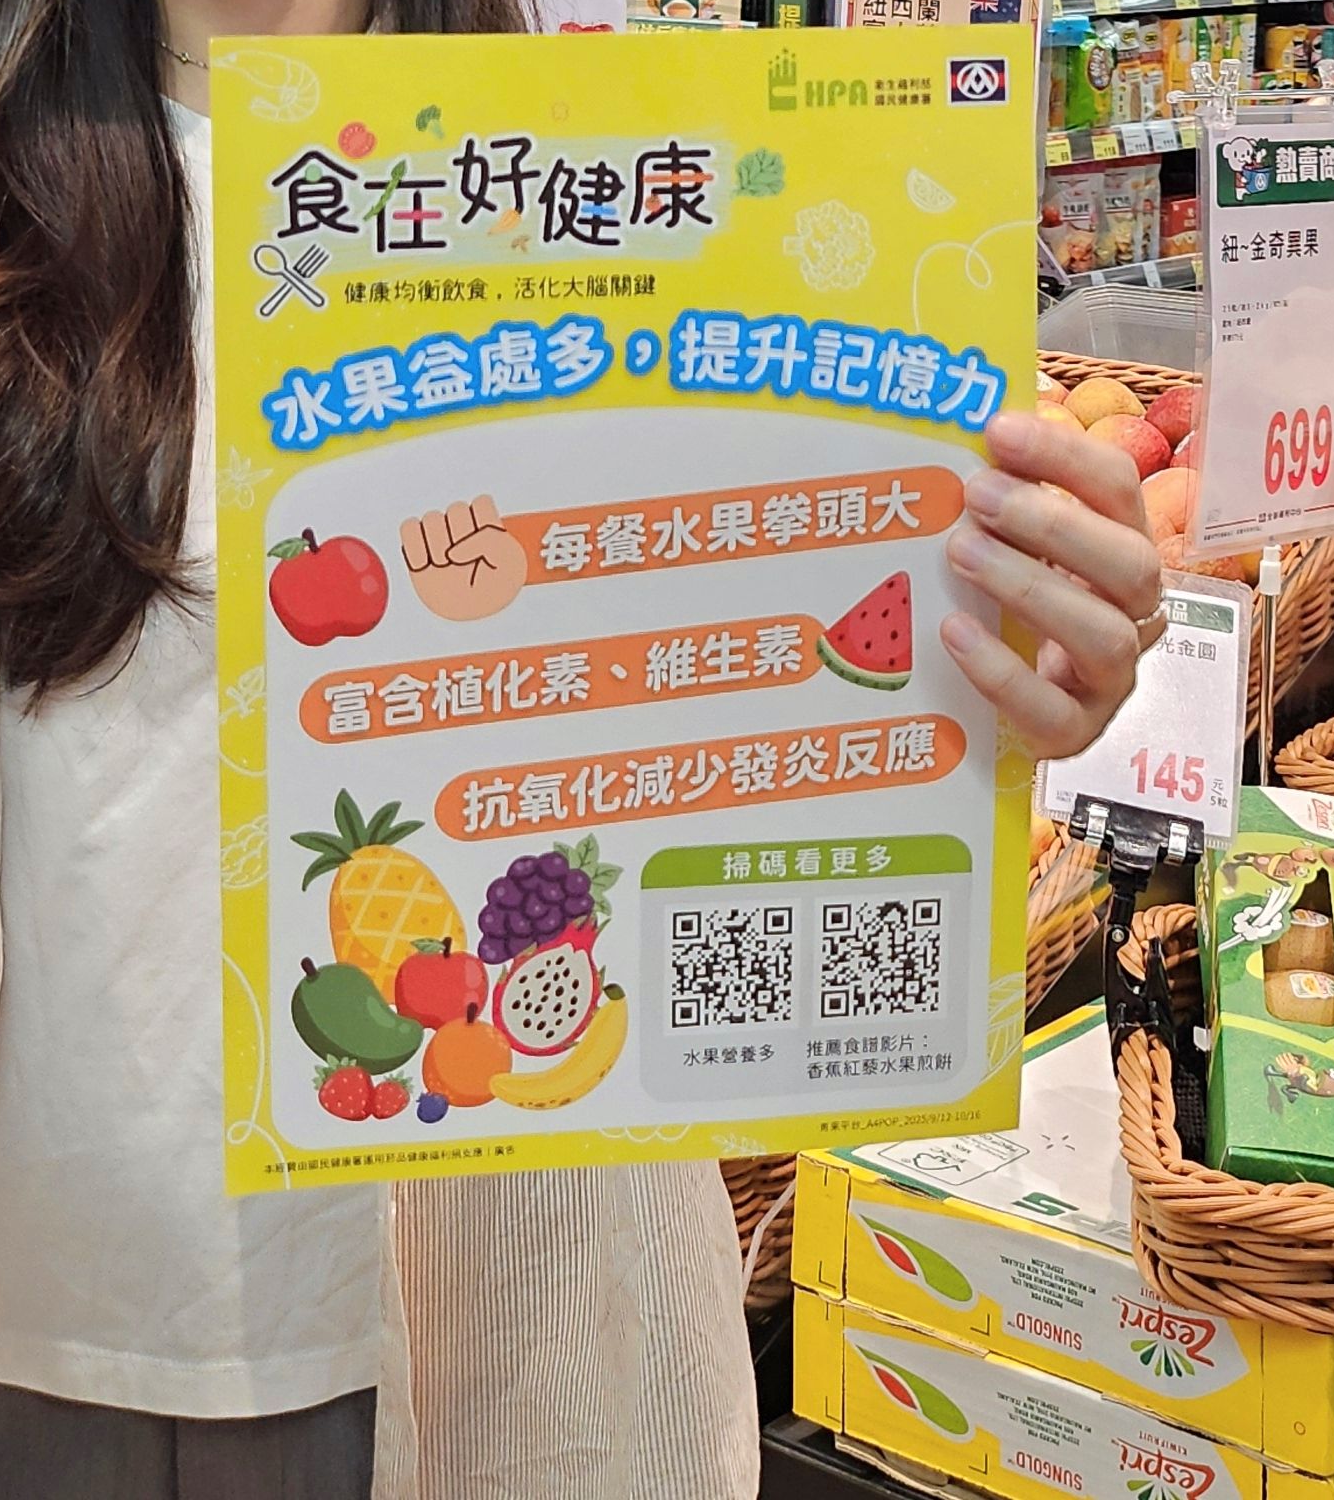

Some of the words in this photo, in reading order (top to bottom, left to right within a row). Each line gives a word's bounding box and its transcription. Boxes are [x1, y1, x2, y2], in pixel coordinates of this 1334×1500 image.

[805, 79, 868, 107] HPA
[270, 137, 714, 253] 食在好健康
[1263, 404, 1334, 496] 699
[538, 478, 924, 575] 每餐水果拳頭大
[322, 623, 806, 737] 富含植化素、維生素
[461, 721, 938, 835] 抗氧化減少發炎反應
[1129, 747, 1206, 803] 145
[722, 844, 893, 881] 掃碼看更多
[682, 1043, 776, 1067] 水果營養多
[1016, 1311, 1083, 1351] SUNGOLD
[1120, 1294, 1216, 1367] Zespri
[1016, 1450, 1083, 1492] SUNGOLD
